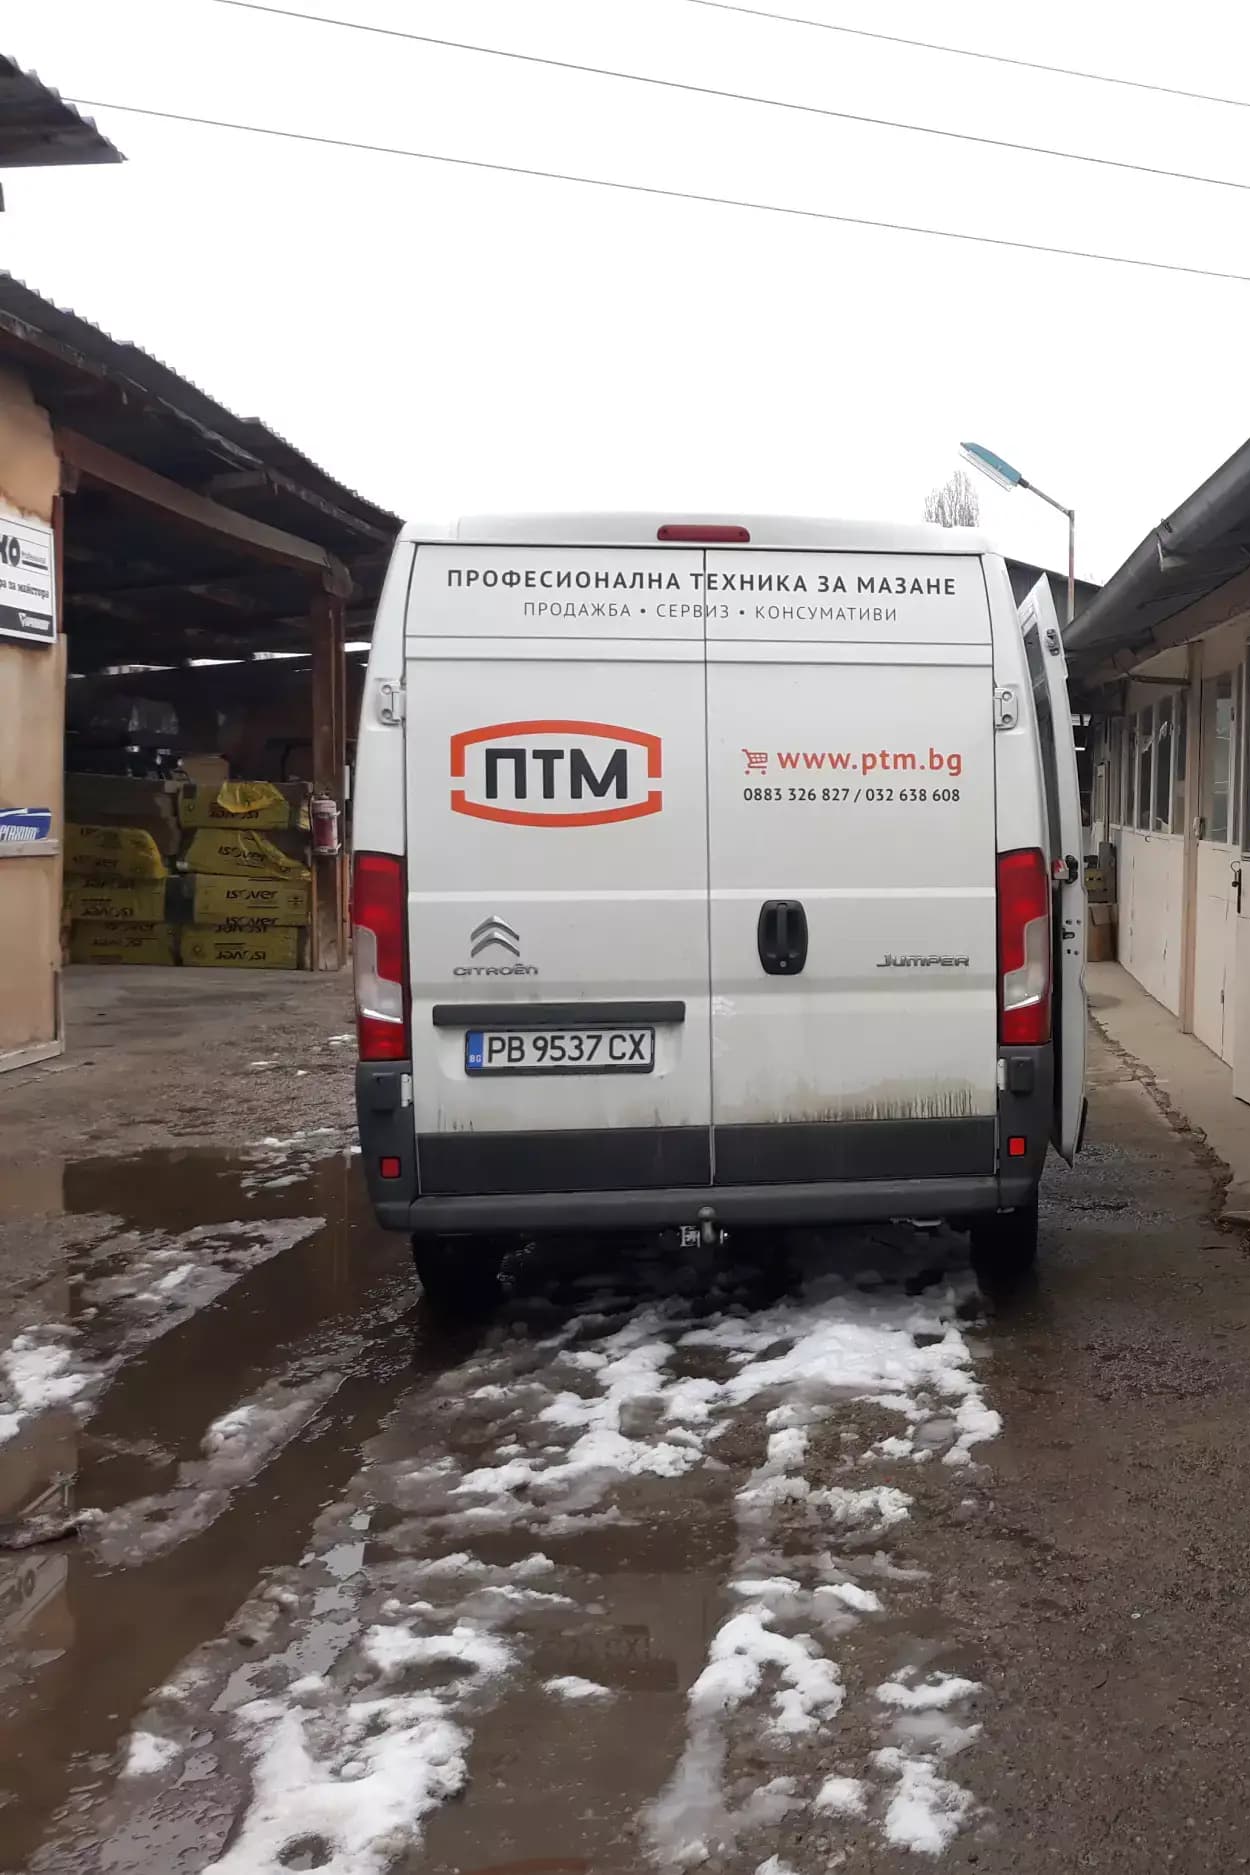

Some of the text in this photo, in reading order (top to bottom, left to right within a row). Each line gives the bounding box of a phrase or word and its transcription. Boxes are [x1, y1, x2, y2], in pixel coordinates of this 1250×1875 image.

[447, 569, 956, 595] ПРОФЕСИОНАЛНА ТЕХНИКА ЗА МАЗАНЕ
[523, 601, 898, 622] ПРОДАЖБА СЕРВИЗ КОНСУМАТИВИ
[484, 747, 629, 800] ПТМ
[776, 748, 963, 777] www.ptm.bg
[743, 787, 783, 802] 0883
[788, 787, 817, 802] 326
[822, 788, 850, 802] 827
[865, 788, 894, 802] 032
[899, 788, 928, 803] 638
[932, 789, 962, 803] 608
[469, 1055, 482, 1064] BG
[532, 1034, 603, 1062] 9537
